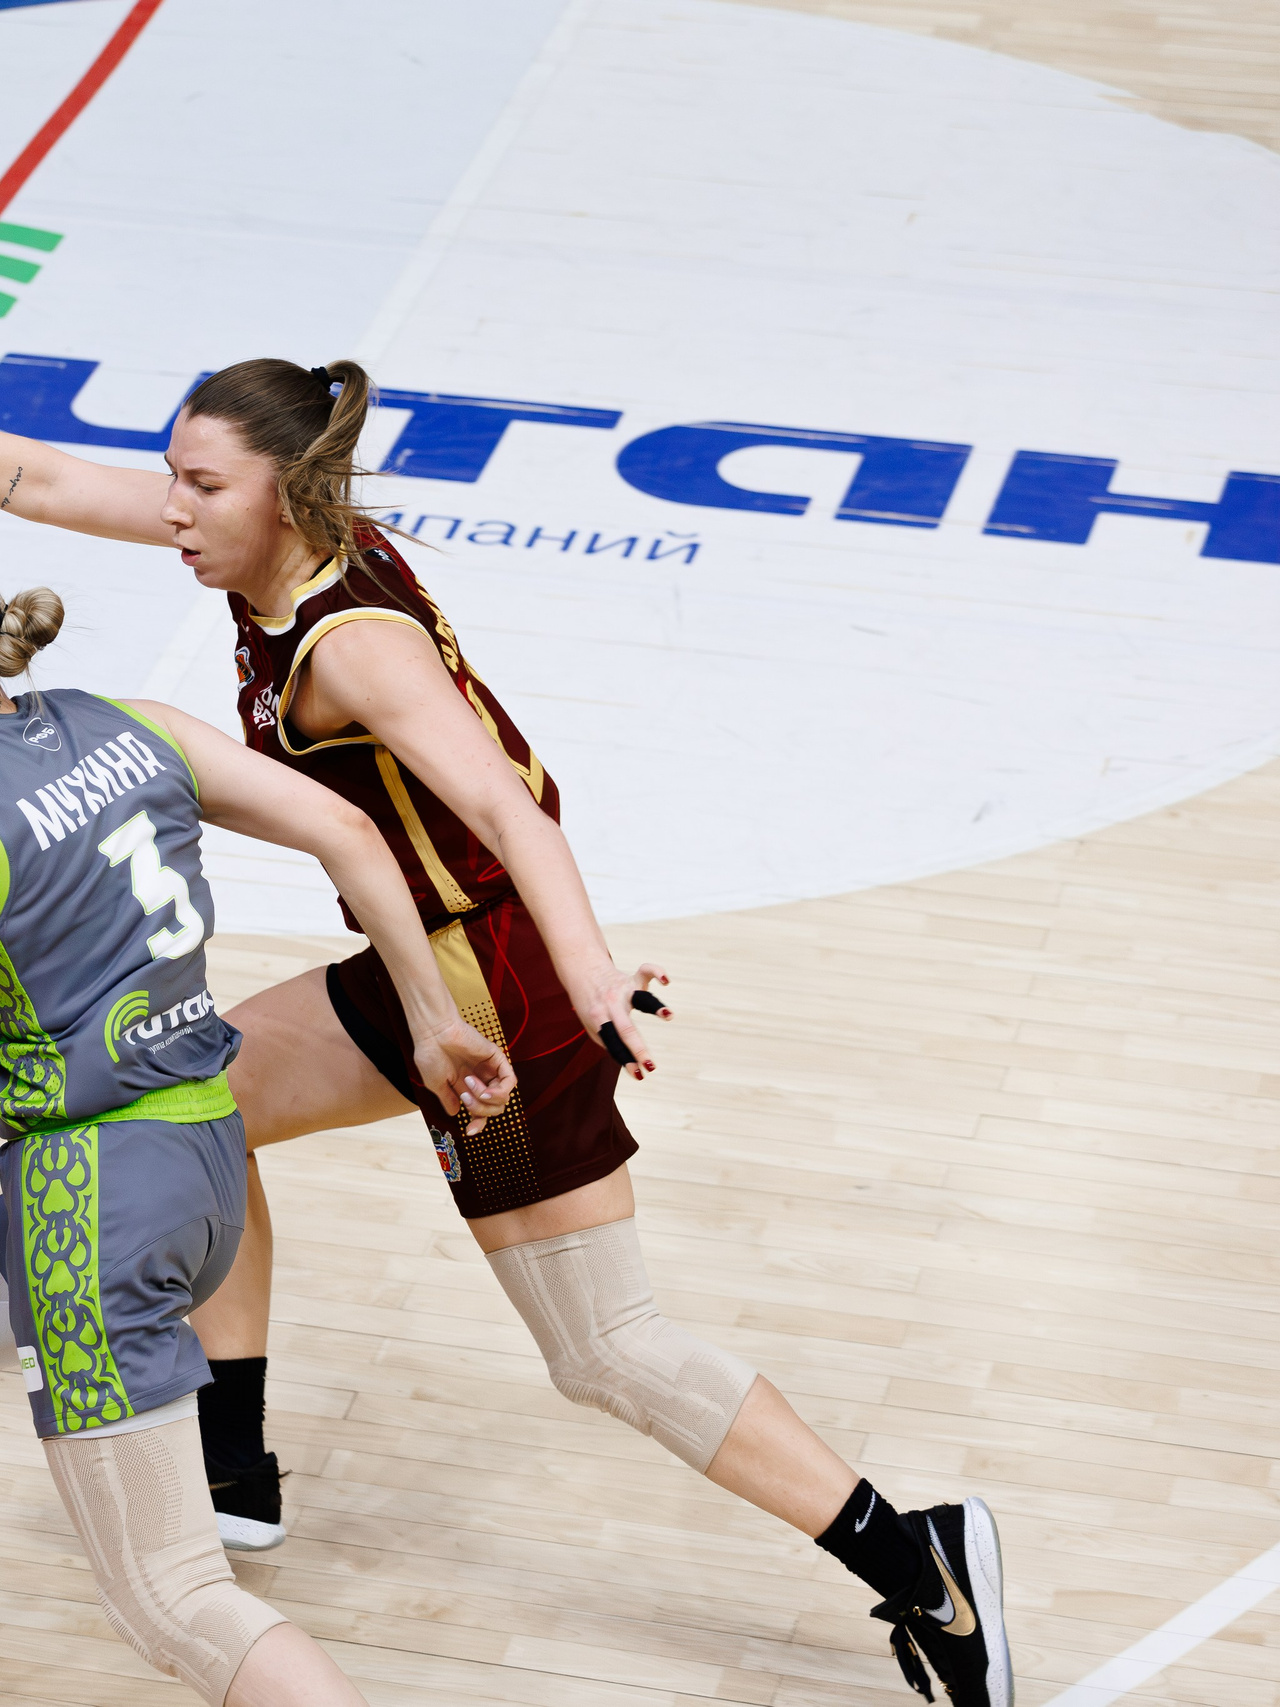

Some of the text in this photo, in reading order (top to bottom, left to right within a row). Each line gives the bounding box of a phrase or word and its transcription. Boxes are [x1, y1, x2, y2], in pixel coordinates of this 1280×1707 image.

[378, 510, 702, 566] паний
[16, 731, 167, 851] МУХИНА
[98, 810, 205, 961] 3
